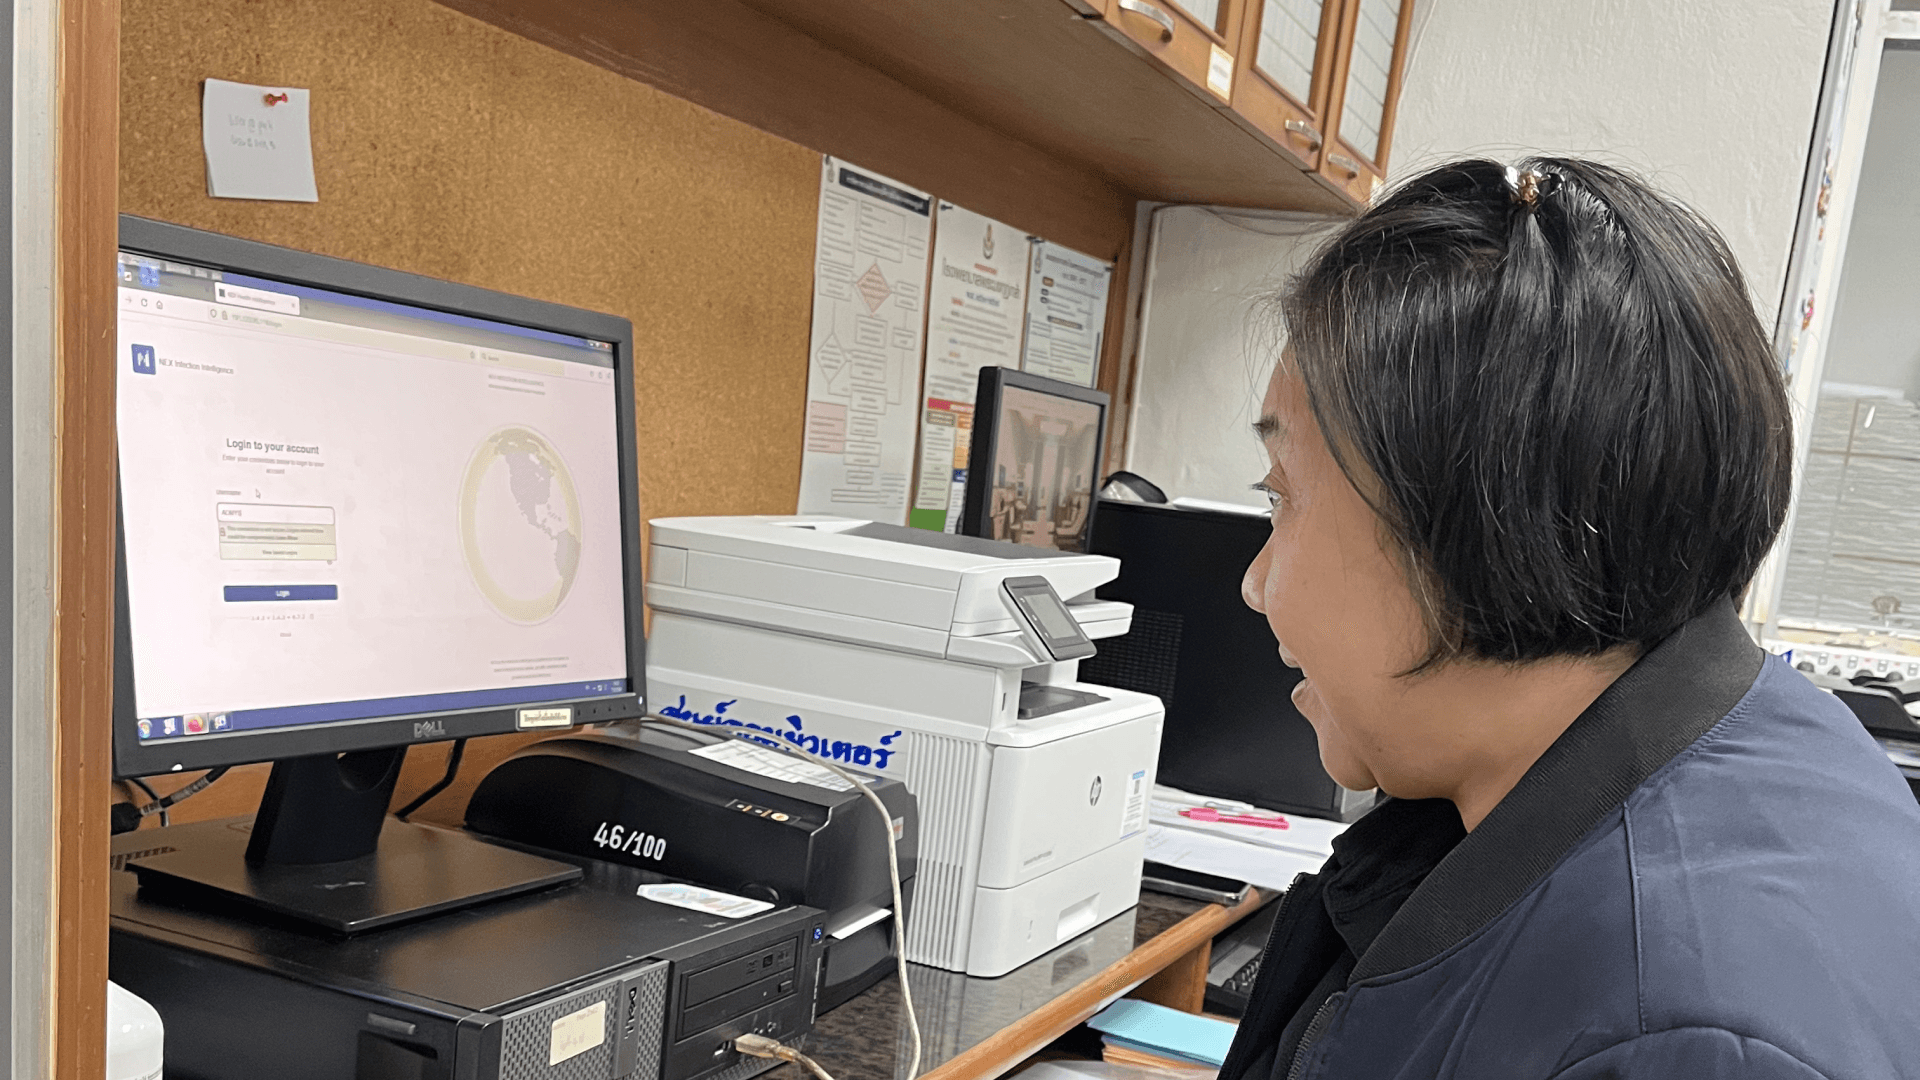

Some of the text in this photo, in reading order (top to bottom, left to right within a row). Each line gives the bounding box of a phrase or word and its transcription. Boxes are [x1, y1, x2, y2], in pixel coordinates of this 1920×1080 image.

[226, 438, 319, 454] Login to your account
[413, 720, 446, 739] DELL
[659, 694, 902, 769] ศนย์คอมพิวเตอร์
[593, 822, 667, 861] 46/100
